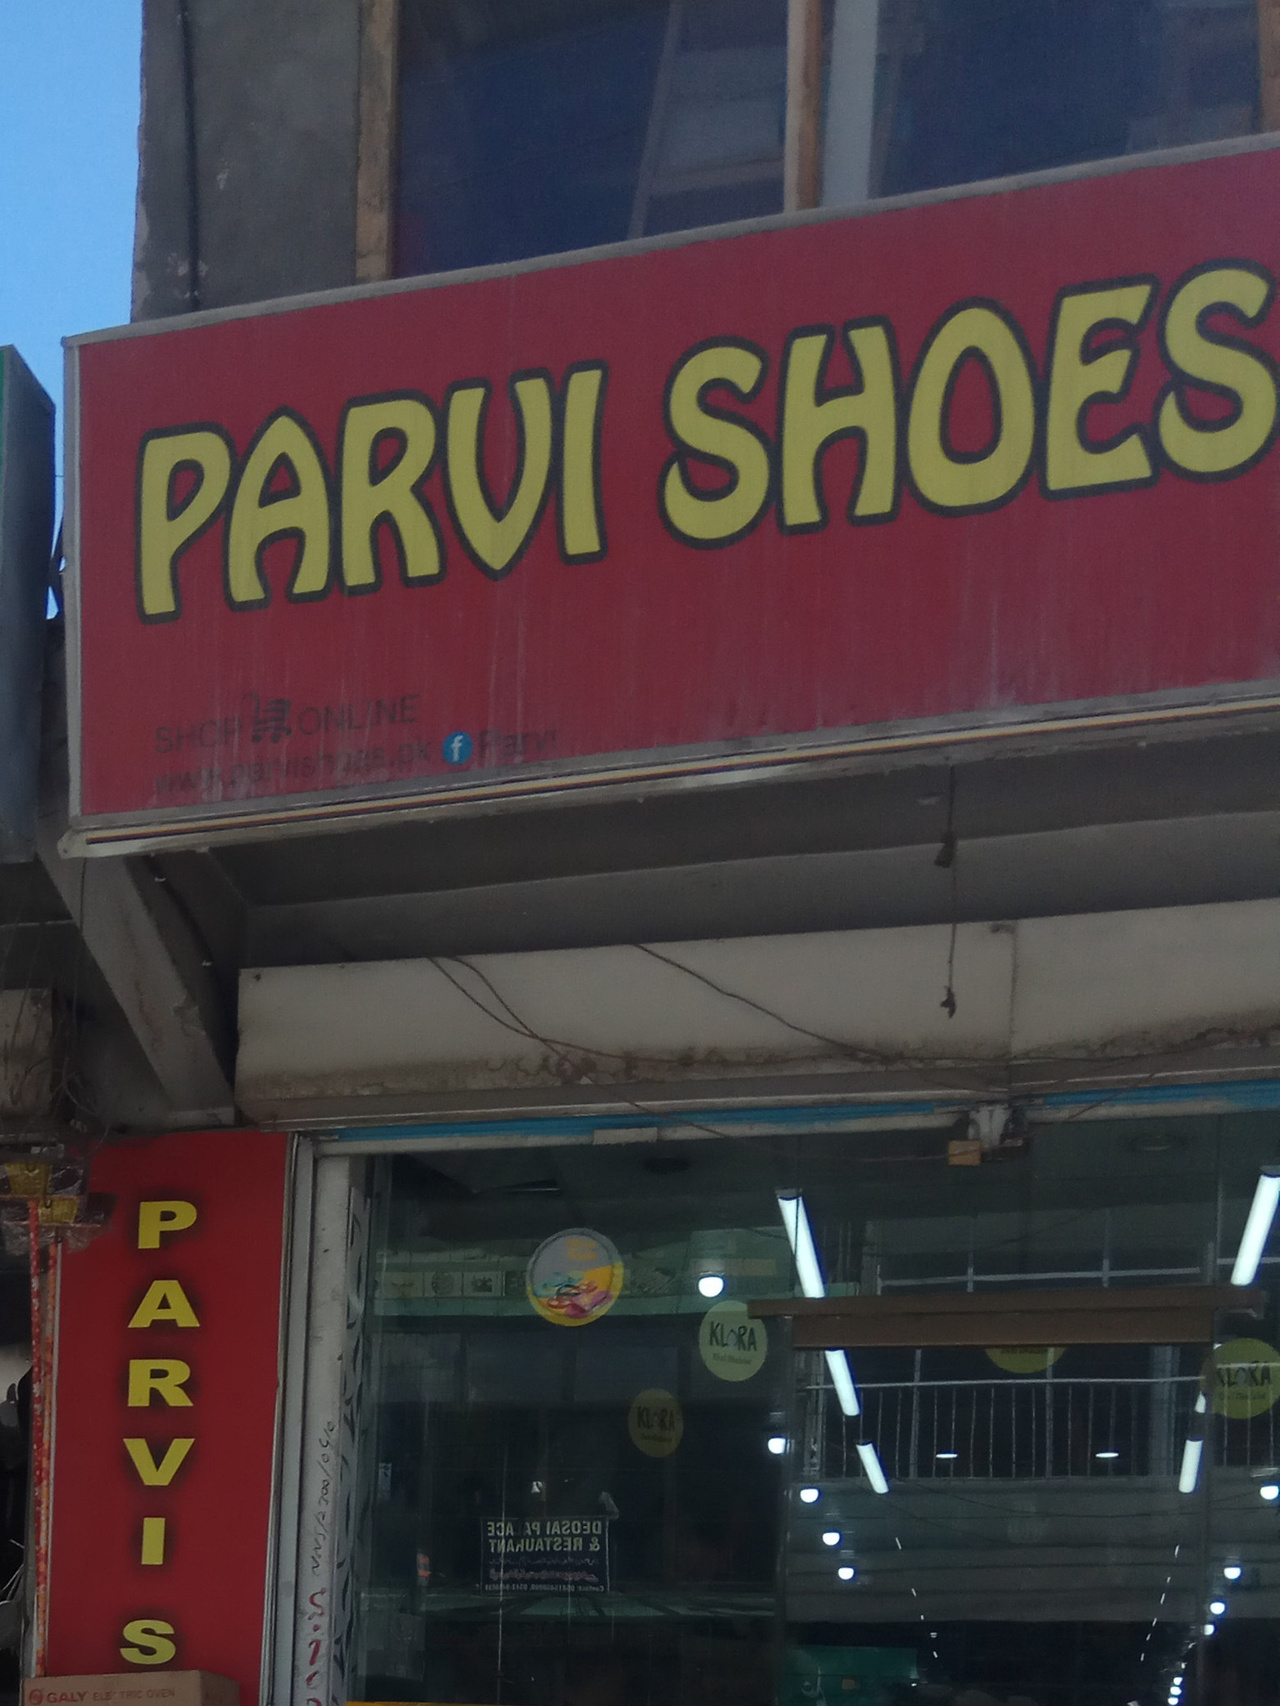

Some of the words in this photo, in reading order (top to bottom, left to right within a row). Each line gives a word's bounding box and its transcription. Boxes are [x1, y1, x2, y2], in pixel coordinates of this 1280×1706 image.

[135, 359, 610, 626] PARVI
[658, 257, 1280, 555] SHOES
[154, 717, 241, 753] SHOP
[298, 694, 419, 736] ONLINE
[120, 1200, 200, 1665] PARVIS
[46, 1691, 88, 1704] GALY
